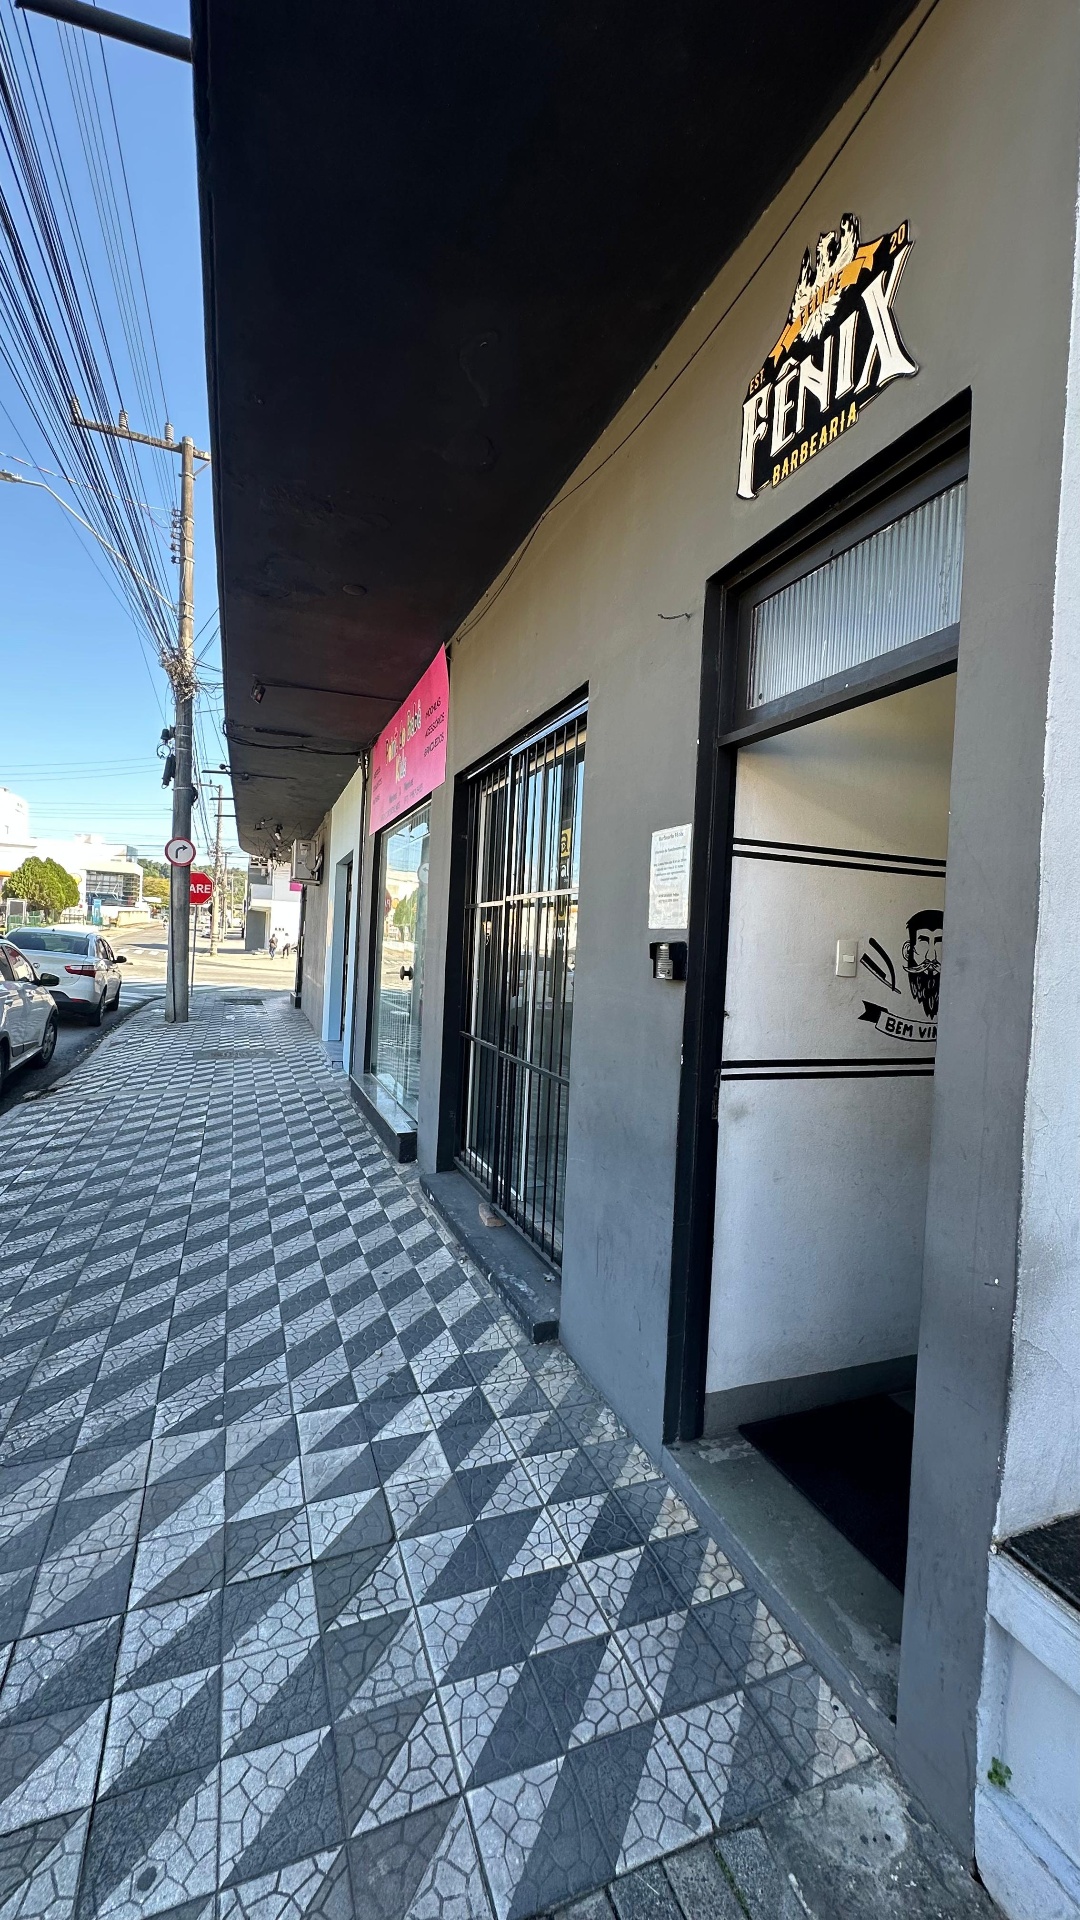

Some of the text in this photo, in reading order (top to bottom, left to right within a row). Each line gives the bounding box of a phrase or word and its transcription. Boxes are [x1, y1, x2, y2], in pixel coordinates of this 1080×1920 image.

[889, 223, 906, 254] 20
[800, 269, 844, 326] FELIPE
[736, 241, 918, 499] FÊNIX
[749, 367, 766, 395] EST.
[771, 401, 858, 488] BARBEARIA
[189, 883, 212, 894] ARE
[884, 1016, 938, 1039] BEM VIN
